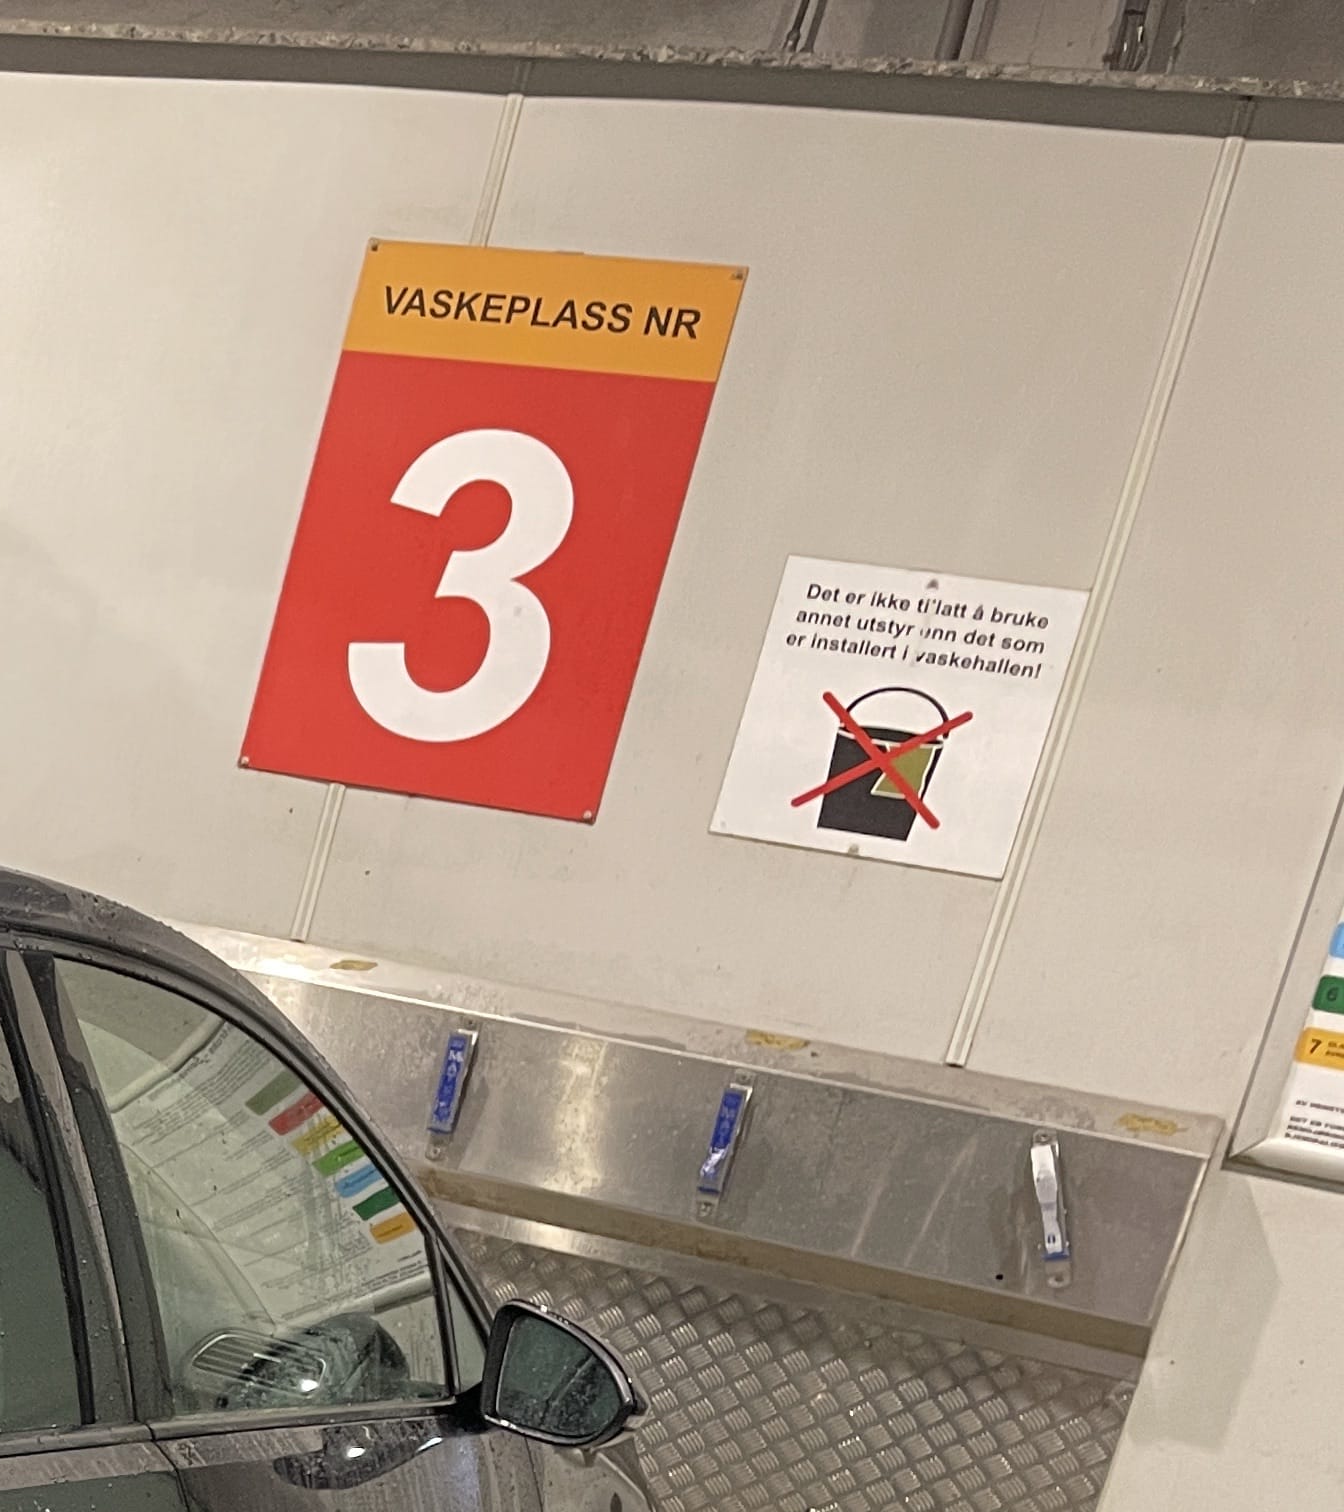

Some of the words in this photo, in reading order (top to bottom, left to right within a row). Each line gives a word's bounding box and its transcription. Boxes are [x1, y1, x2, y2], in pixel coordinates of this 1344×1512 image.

[385, 285, 633, 333] VASKEPLASS
[643, 306, 702, 339] NR
[348, 428, 574, 742] 3
[807, 583, 840, 602] Det
[845, 592, 866, 605] er
[870, 591, 911, 611] ikke
[916, 599, 967, 618] tilatt
[972, 604, 984, 620] å
[990, 606, 1049, 629] bruke
[796, 610, 851, 629] annet
[856, 617, 915, 639] utstyr
[963, 629, 995, 647] det
[1001, 637, 1045, 654] som
[786, 633, 806, 646] er
[811, 633, 897, 659] installert
[902, 645, 909, 660] i
[915, 651, 1042, 679] vaskehallen!
[1309, 1038, 1322, 1055] 7
